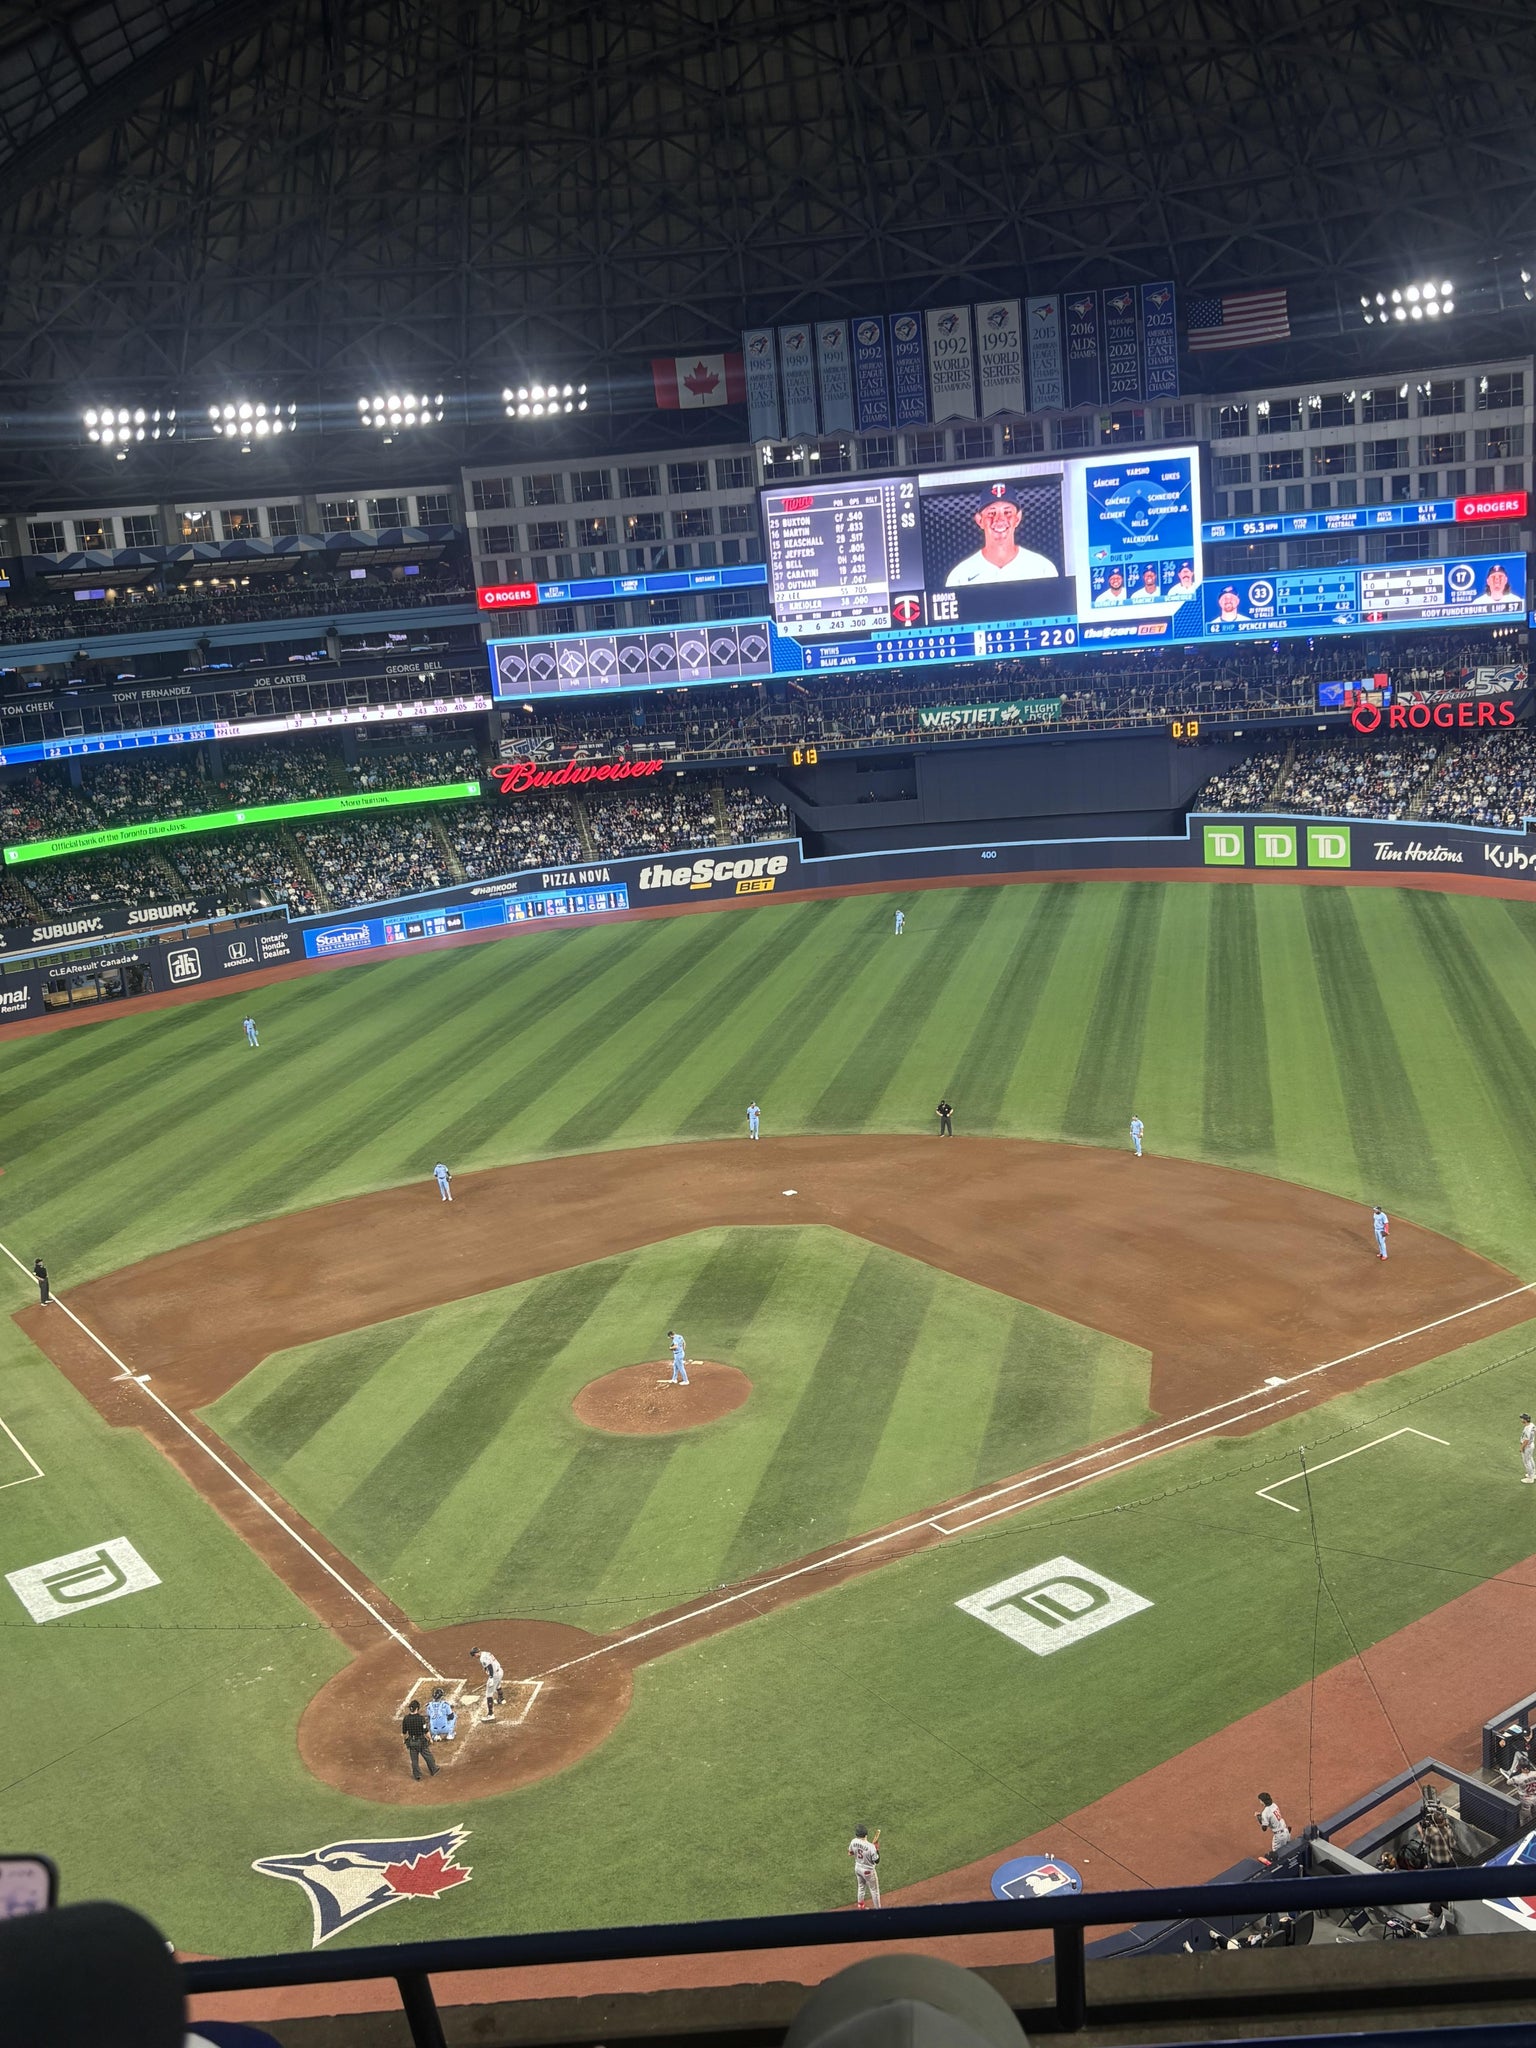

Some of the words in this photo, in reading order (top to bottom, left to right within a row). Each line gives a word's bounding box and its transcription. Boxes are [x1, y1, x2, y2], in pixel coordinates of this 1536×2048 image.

[1147, 313, 1173, 327] 2025
[1033, 327, 1056, 340] 2015
[1071, 323, 1094, 335] 2016
[1110, 327, 1134, 339] 2016
[933, 337, 967, 356] 1992
[982, 331, 1017, 351] 1993
[1071, 338, 1096, 350] ALDS
[859, 347, 882, 360] 1992
[896, 342, 919, 355] 1993
[1070, 350, 1096, 359] CHAMPS
[1110, 343, 1136, 357] 2020
[1148, 346, 1174, 357] EAST
[824, 352, 844, 363] 1991
[983, 352, 1019, 366] WORLD
[750, 360, 772, 371] 1985
[933, 357, 970, 371] WORLD
[1110, 361, 1136, 375] 2022
[933, 369, 970, 384] SERIES
[983, 364, 1020, 379] SERIES
[1150, 369, 1176, 382] ALCS
[934, 382, 971, 393] CHAMPIONS
[984, 377, 1021, 387] CHAMPIONS
[1111, 379, 1137, 392] 2023
[1149, 382, 1176, 391] CHAMPS
[1035, 383, 1059, 395] ALDS
[862, 402, 887, 414] ALCS
[900, 398, 924, 410] ALCS
[1126, 467, 1150, 476] VARSHO
[1161, 472, 1180, 481] LUKES
[900, 483, 914, 499] 22
[1148, 492, 1180, 502] SCHNEIDER
[1148, 506, 1178, 515] GUERRERO
[1477, 500, 1519, 513] ROGERS
[901, 513, 915, 527] SS
[1100, 511, 1126, 520] CLEMENT
[1325, 513, 1357, 522] FOUR-SEAM
[782, 517, 810, 527] BUXTON
[1131, 519, 1149, 527] MILES
[1243, 522, 1264, 534] 95.3
[1266, 523, 1278, 531] MPH
[1328, 520, 1355, 529] FASTBALL
[783, 528, 810, 538] MARTIN
[784, 536, 824, 549] KEASCHALL
[1123, 535, 1159, 544] VALENZUELA
[785, 548, 815, 559] JEFFERS
[786, 560, 803, 569] BELL
[1128, 565, 1139, 574] 12
[1163, 562, 1175, 571] 36
[787, 569, 818, 580] CARATINI
[1093, 568, 1105, 577] 27
[1455, 572, 1467, 583] 17
[788, 579, 816, 590] OUTMAN
[495, 590, 532, 601] ROGERS
[1254, 588, 1267, 599] 33
[933, 600, 959, 620] LEE
[1422, 609, 1440, 618] KODY
[1442, 606, 1488, 616] FUNDERBURK
[1491, 604, 1505, 613] LHP
[1508, 603, 1519, 612] 57
[850, 619, 866, 628] .300
[872, 617, 888, 626] .405
[1211, 624, 1220, 633] 62
[1238, 621, 1266, 631] SPENCER
[1268, 620, 1287, 629] MILES
[1084, 626, 1137, 638] theScore
[820, 647, 839, 656] TWINS
[386, 664, 420, 674] GEORGE
[424, 662, 442, 671] BELL
[821, 658, 838, 667] BLUE
[840, 657, 856, 665] JAYS
[254, 677, 271, 687] JOE
[274, 674, 307, 685] CARTER
[112, 692, 137, 702] TONY
[141, 686, 192, 699] FERNANDEZ
[1, 706, 23, 716] TOM
[25, 701, 55, 713] CHEEK
[1024, 703, 1060, 714] FLIGHT
[1389, 701, 1516, 729] ROGERS
[1172, 721, 1199, 738] 0:13
[792, 749, 818, 766] 0:13
[491, 756, 664, 794] Budweiser
[340, 799, 361, 808] More
[51, 839, 78, 852] Official
[79, 837, 96, 848] bank
[98, 835, 105, 844] of
[105, 833, 119, 843] the
[120, 830, 148, 842] Toronto
[148, 826, 166, 836] Blue
[1208, 833, 1240, 858] TD
[1258, 834, 1292, 858] TD
[1311, 834, 1346, 859] TD
[980, 850, 997, 859] 400
[1373, 841, 1402, 861] Tim
[1405, 841, 1463, 863] Hortons
[542, 871, 576, 888] PIZZA
[579, 868, 610, 884] NOVA
[639, 855, 788, 890] theScore
[740, 879, 771, 892] BET
[127, 902, 200, 926] SUBWAY
[31, 917, 104, 943] SUBWAY
[261, 933, 289, 944] Ontario
[316, 930, 370, 947] Starlane
[262, 941, 286, 951] Honda
[263, 948, 291, 960] Dealers
[49, 962, 98, 978] CLEAResult
[100, 955, 131, 969] Canada
[224, 957, 254, 969] HONDA
[1, 1001, 27, 1013] Rental
[44, 1549, 128, 1604] TD
[987, 1575, 1112, 1630] TD
[857, 1848, 864, 1860] 5
